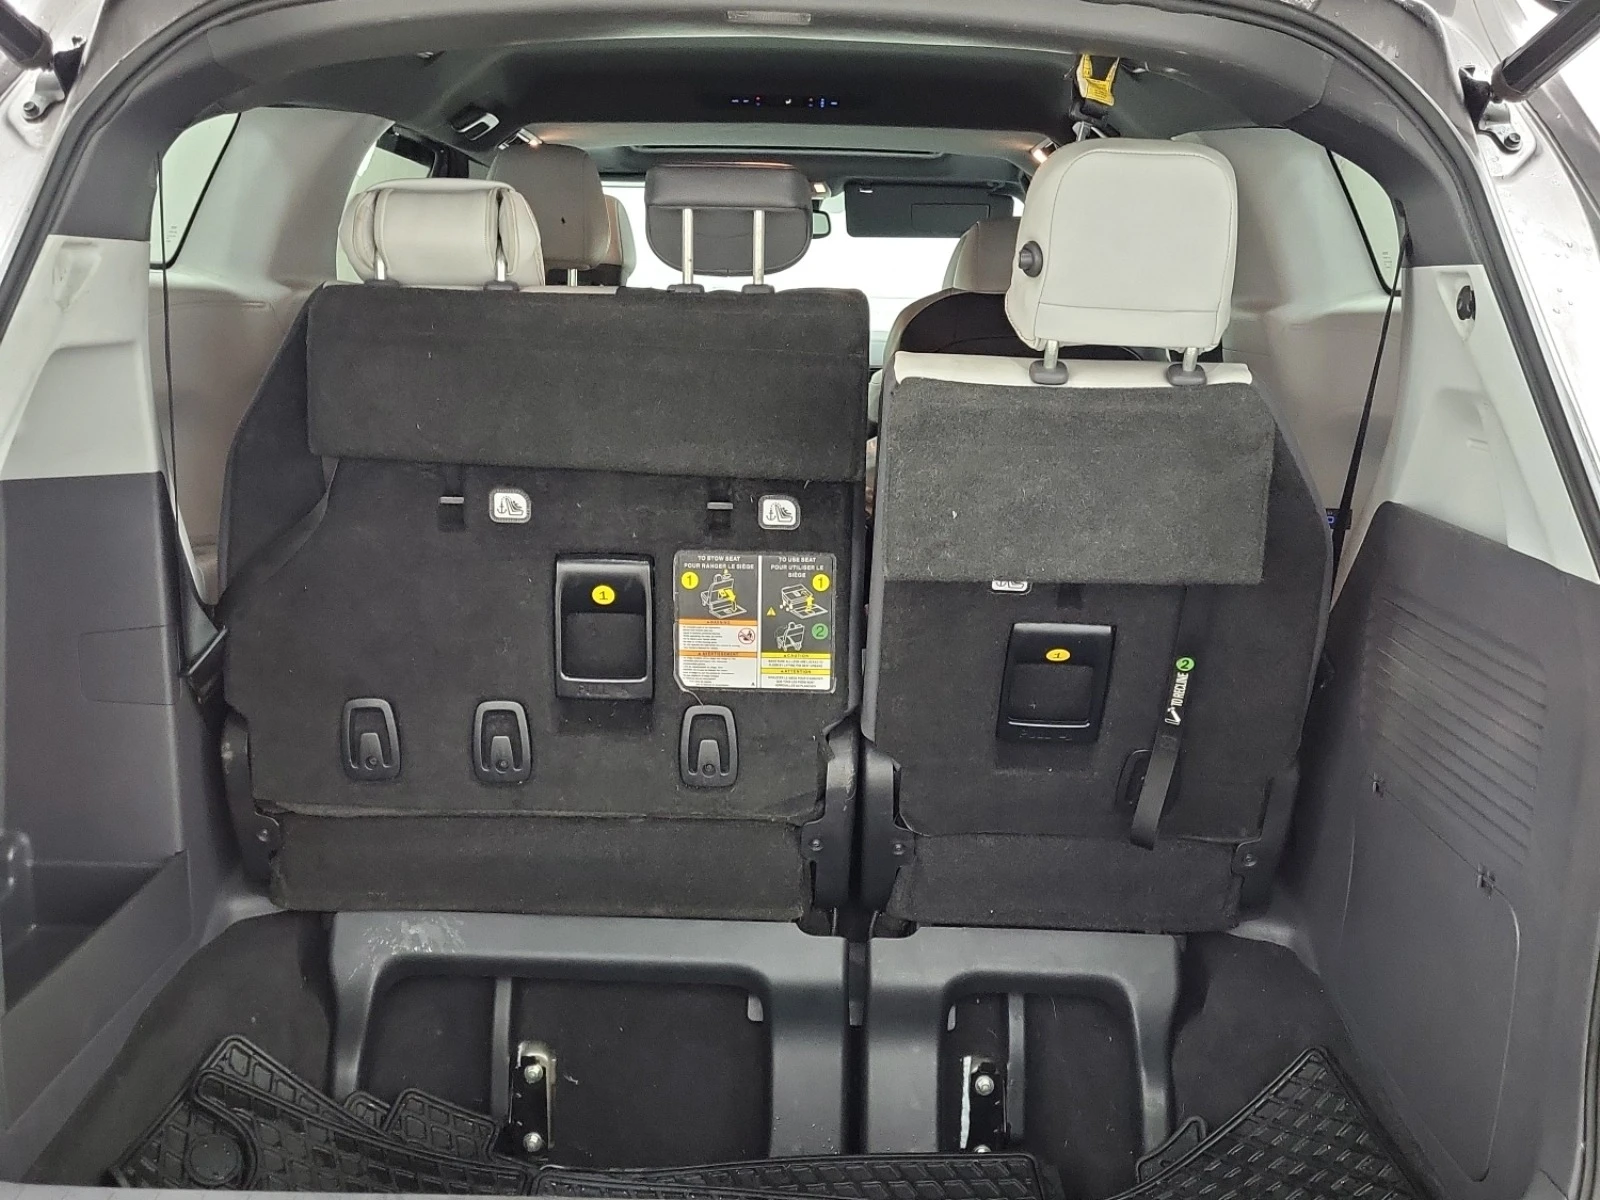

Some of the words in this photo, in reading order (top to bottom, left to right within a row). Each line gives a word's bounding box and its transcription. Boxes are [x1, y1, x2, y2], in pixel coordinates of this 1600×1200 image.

[686, 574, 692, 586] 1
[818, 577, 823, 588] 1
[599, 591, 608, 600] 1
[816, 626, 824, 638] 2
[1180, 658, 1190, 670] 2
[1172, 672, 1189, 699] RECLINE
[1170, 698, 1184, 706] TO
